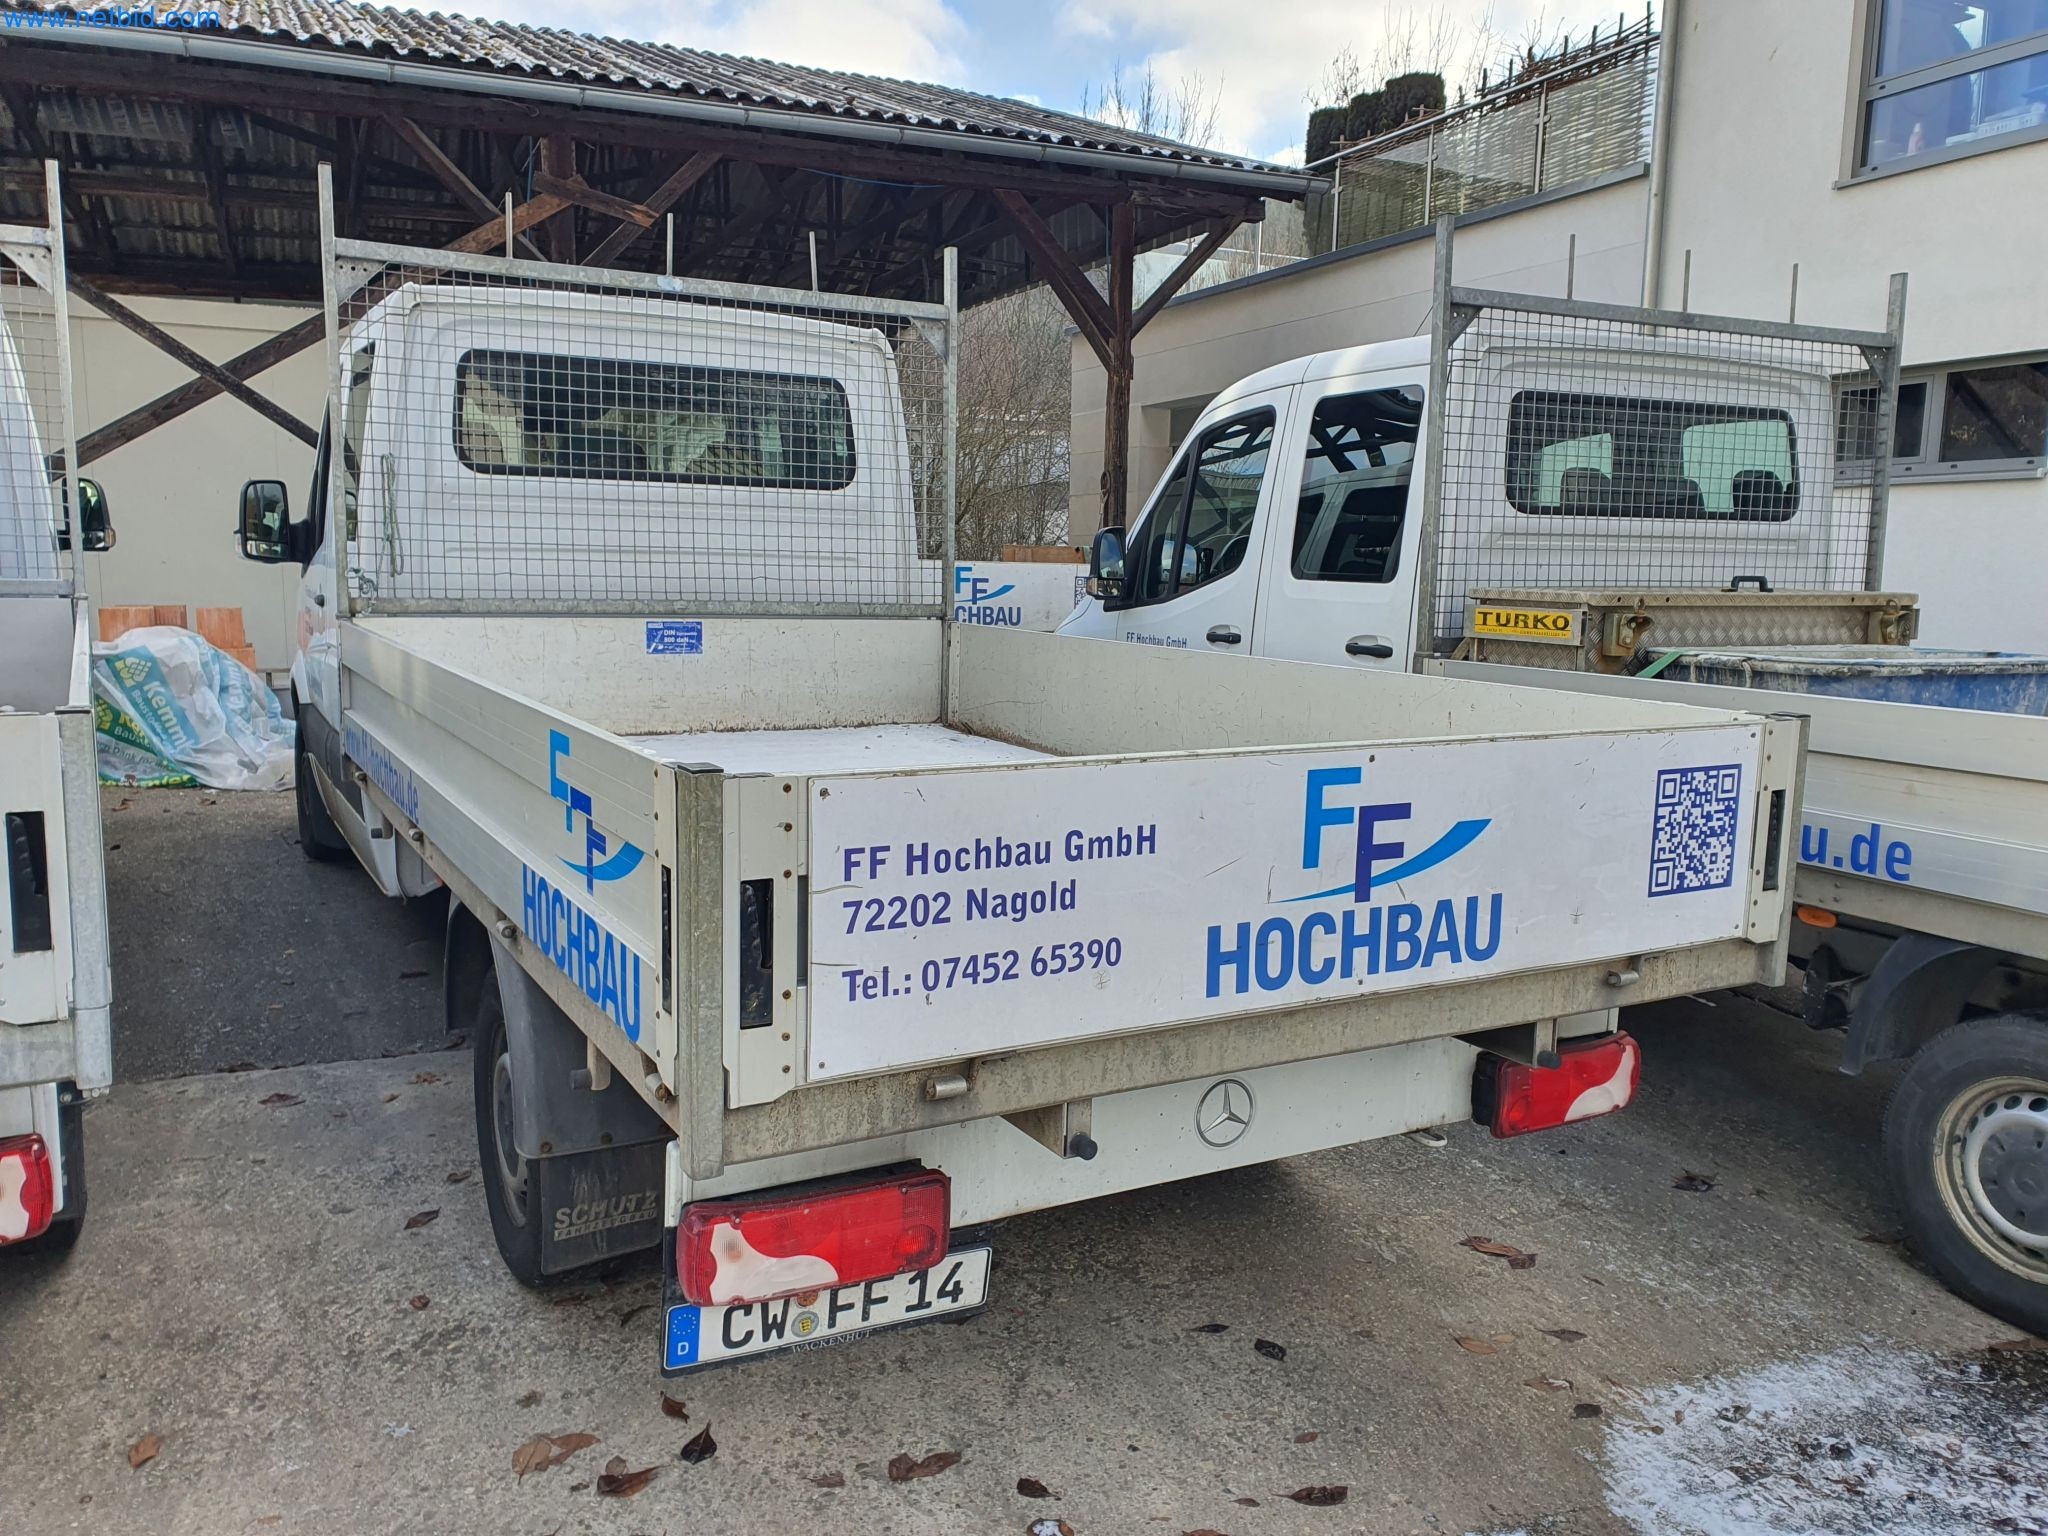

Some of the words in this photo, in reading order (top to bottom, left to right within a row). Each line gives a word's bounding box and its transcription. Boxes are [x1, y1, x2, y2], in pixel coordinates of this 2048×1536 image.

[954, 605, 1022, 626] CHBAU
[955, 566, 989, 605] FF
[1126, 631, 1136, 643] FF
[1136, 633, 1165, 646] Hochbau
[1166, 635, 1188, 649] GmbH
[1477, 611, 1571, 631] TURKO
[549, 728, 607, 897] FF
[1302, 766, 1412, 904] FF
[842, 844, 892, 883] FF
[904, 835, 1052, 877] Hochbau
[1063, 823, 1157, 863] GmbH
[1800, 822, 1913, 882] u.de
[842, 890, 951, 935] 72202
[965, 878, 1077, 923] Nagold
[522, 862, 641, 1044] HOCHBAU
[841, 965, 912, 1002] Tel.:
[921, 949, 1020, 992] 07452
[1029, 936, 1123, 978] 65390
[1205, 892, 1503, 999] HOCHBAU
[721, 1297, 792, 1350] CW
[826, 1276, 896, 1330] FF
[904, 1260, 965, 1313] 14
[677, 1341, 689, 1356] D
[791, 1329, 874, 1354] WACKENHUT
